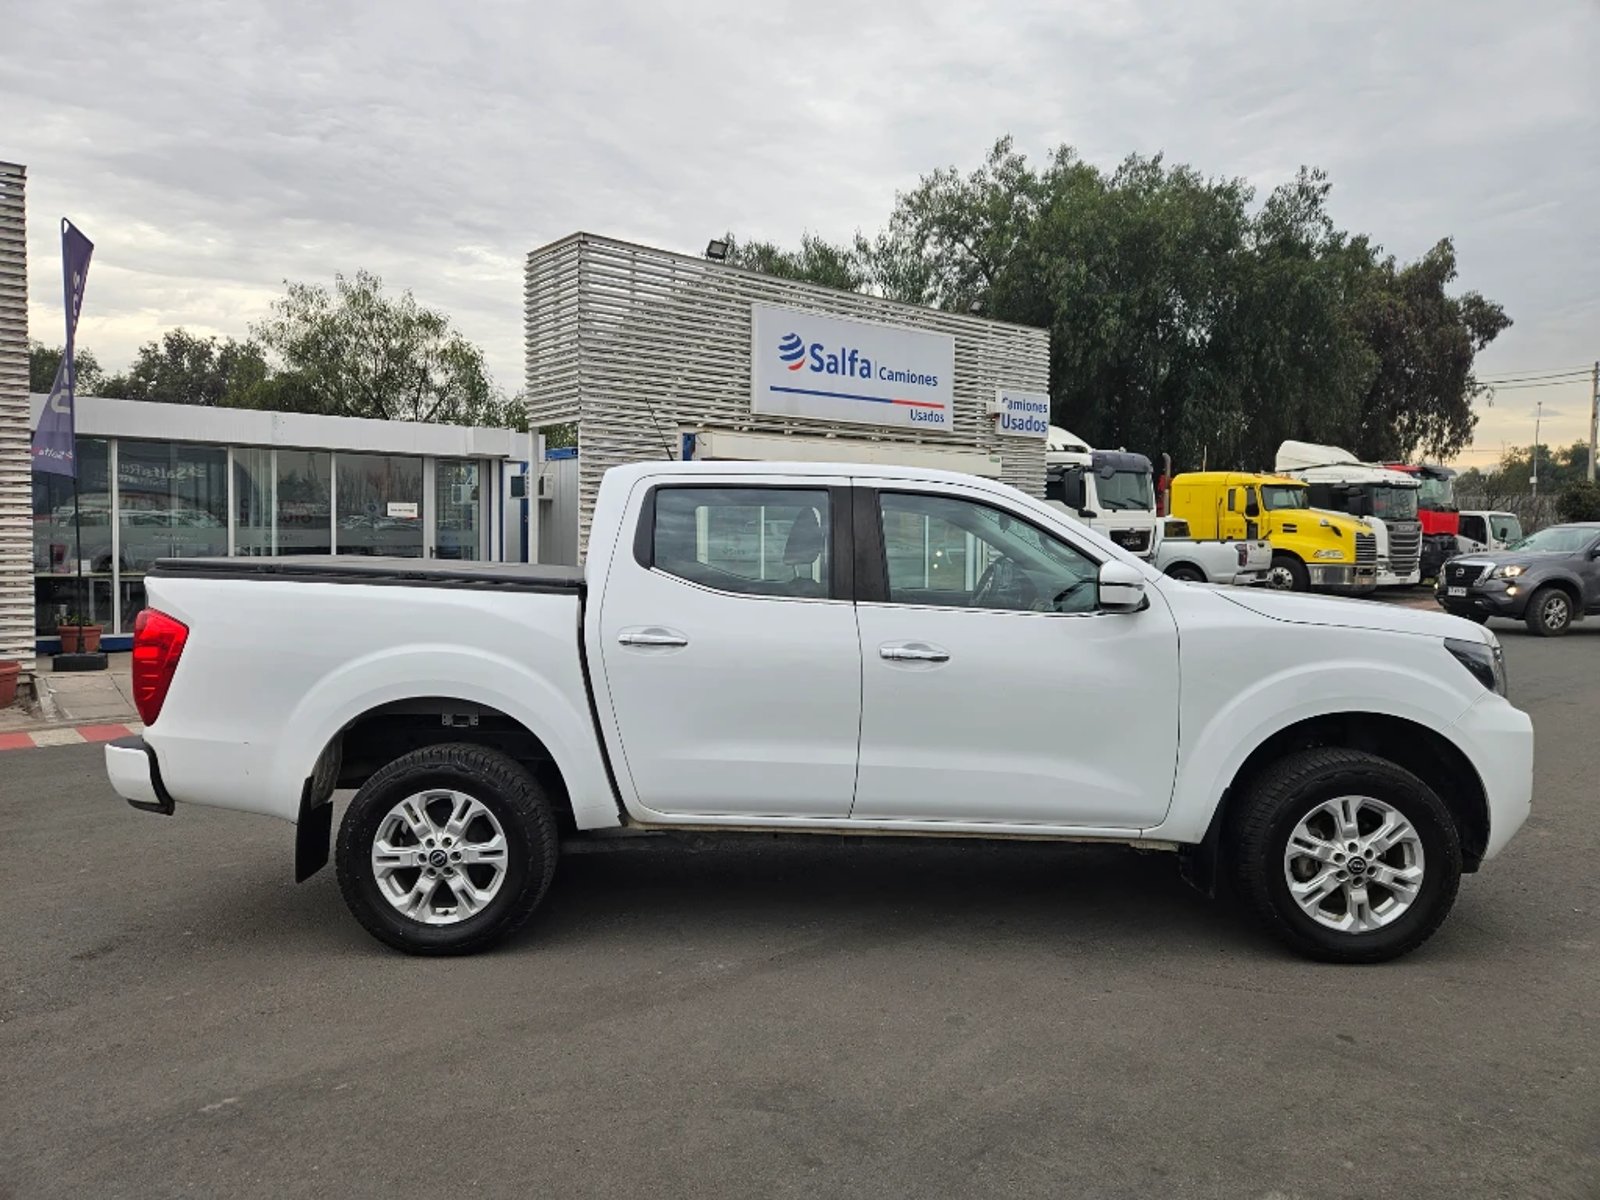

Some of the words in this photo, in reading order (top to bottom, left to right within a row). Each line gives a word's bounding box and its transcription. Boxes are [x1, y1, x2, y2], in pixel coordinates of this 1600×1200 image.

[809, 343, 871, 379] Salfa
[879, 366, 938, 387] Camiones
[910, 408, 945, 423] Usados
[1002, 413, 1048, 433] Usados
